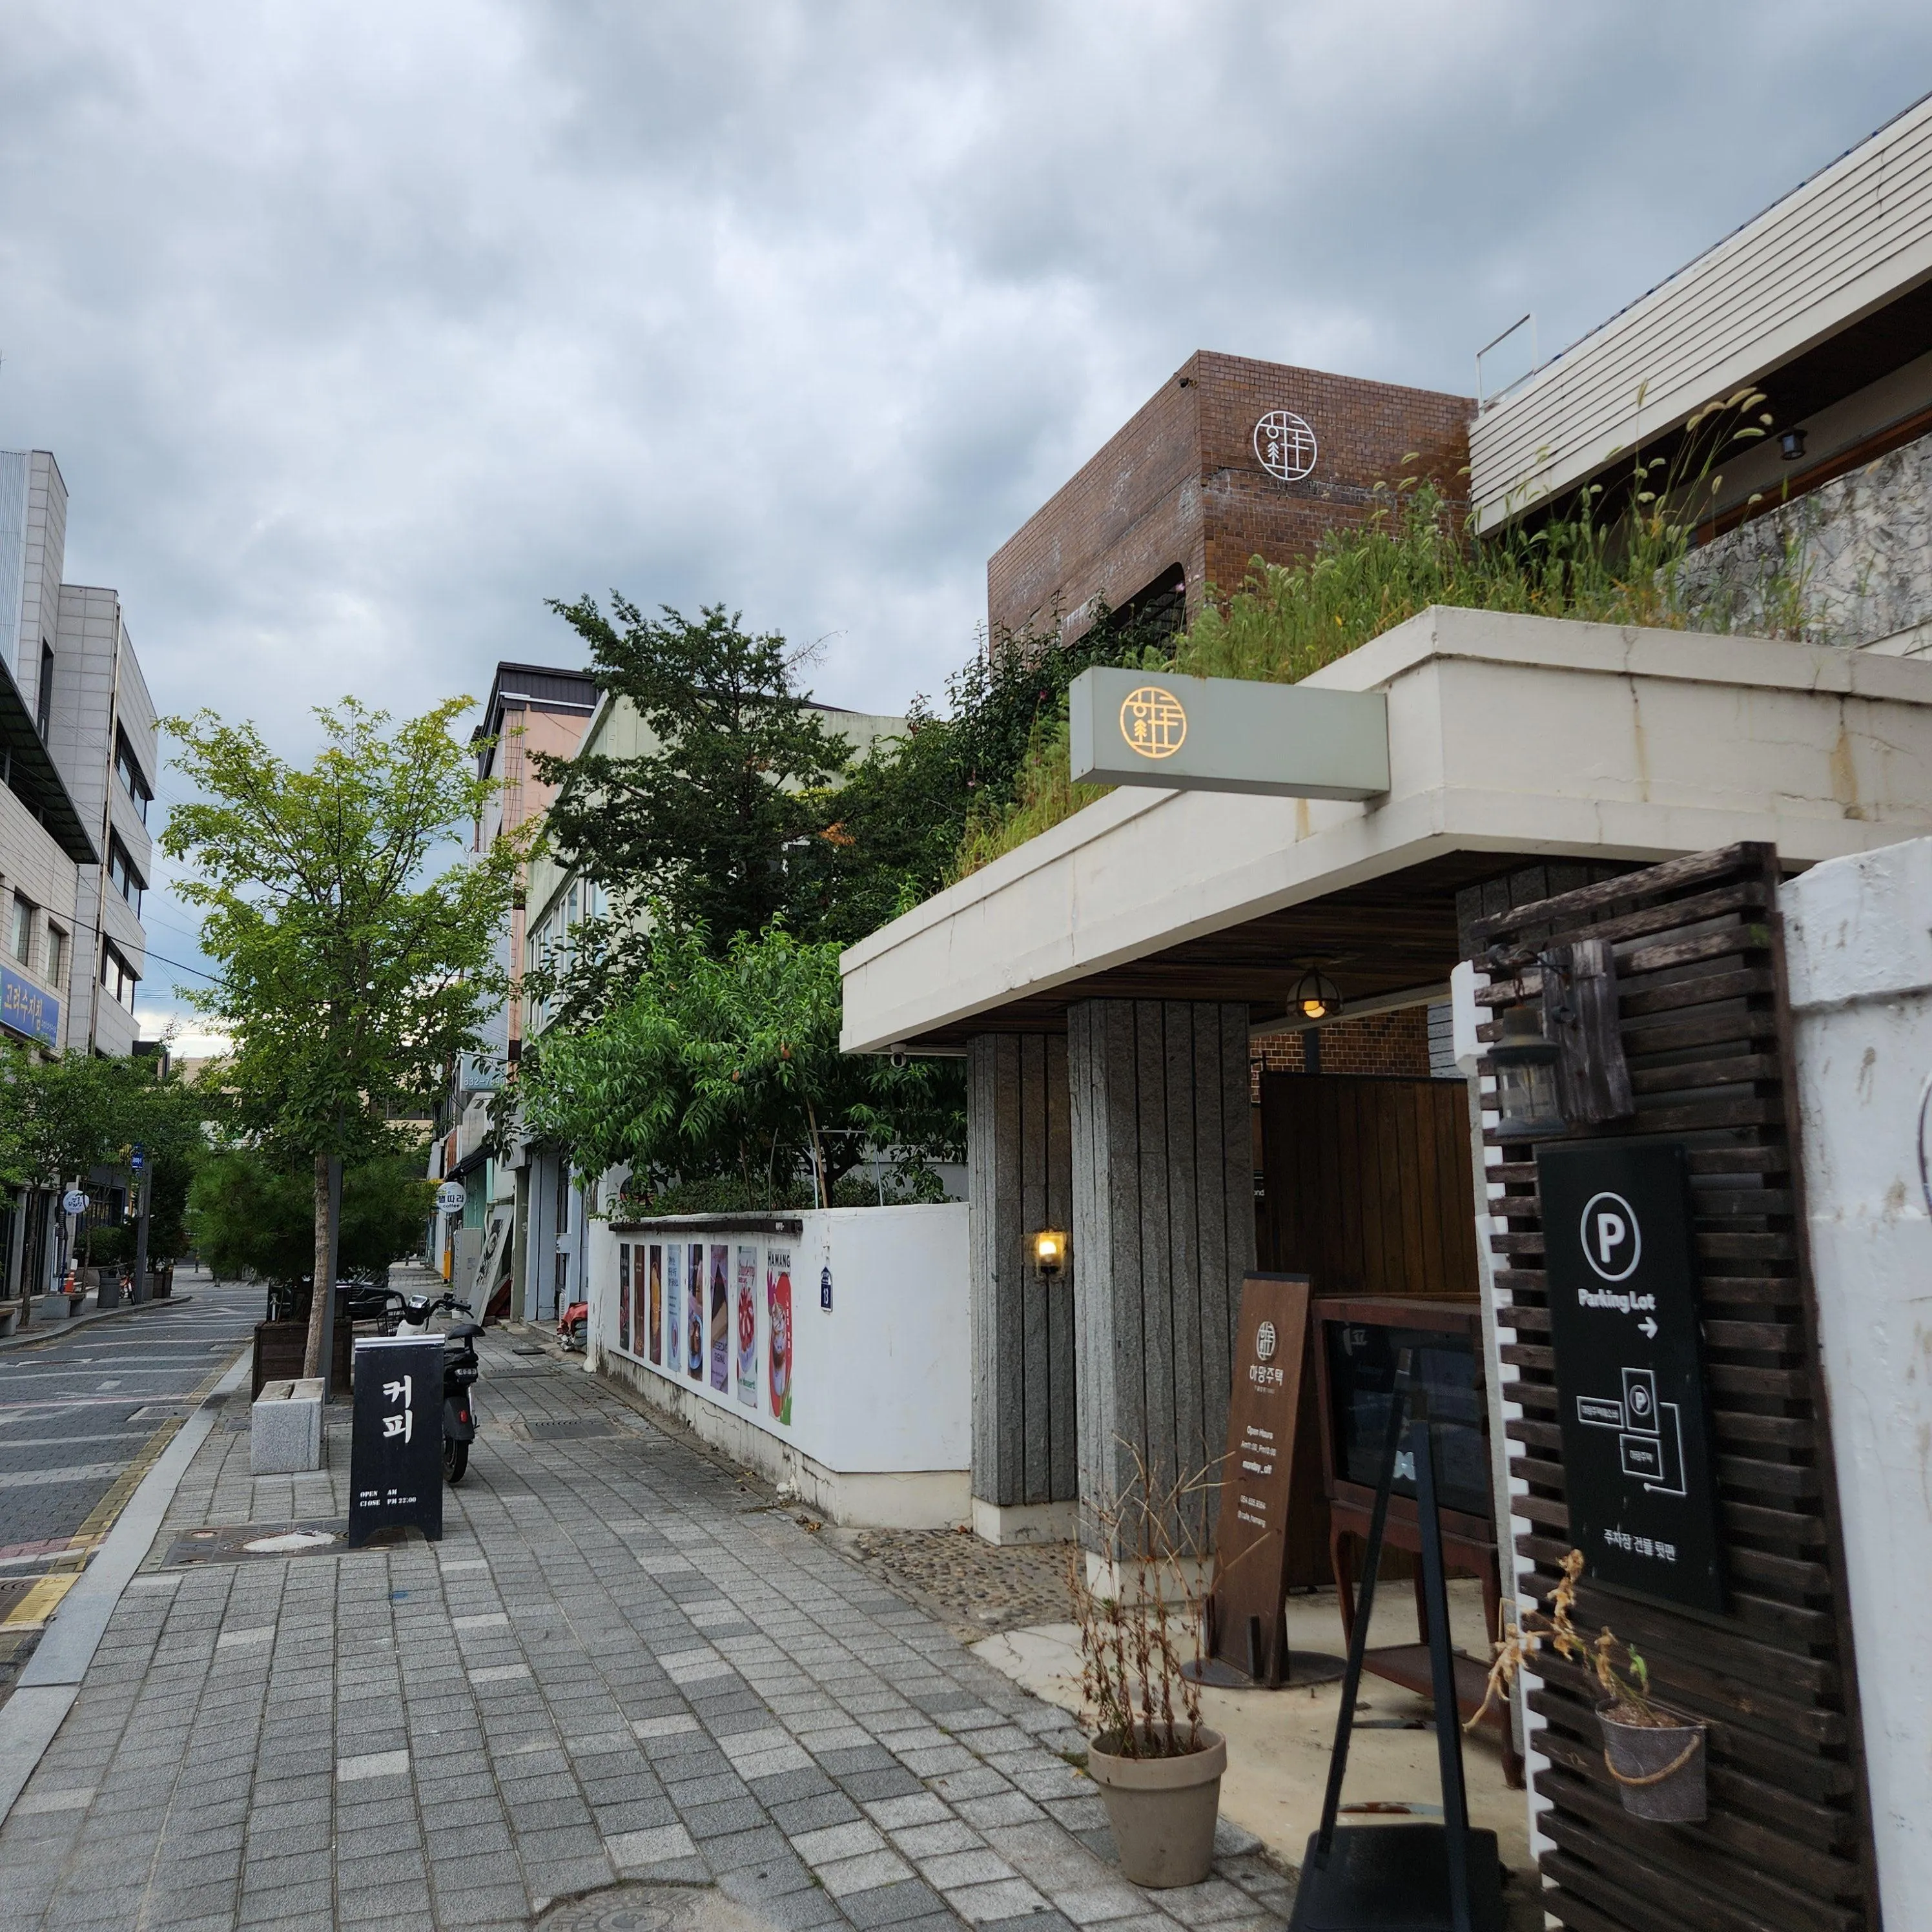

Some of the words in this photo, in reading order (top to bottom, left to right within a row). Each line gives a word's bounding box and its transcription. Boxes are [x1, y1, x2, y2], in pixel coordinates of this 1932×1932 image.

[4, 983, 42, 1031] 고려수지침
[438, 1194, 464, 1204] 별따라
[768, 1250, 790, 1268] HAMANG
[823, 1288, 828, 1304] 13
[1577, 1288, 1630, 1314] Parking
[1629, 1291, 1656, 1311] Lot
[1249, 1364, 1283, 1386] 하망주택
[382, 1375, 413, 1443] 커피
[1603, 1528, 1632, 1550] 주차장
[1632, 1536, 1654, 1556] 건물
